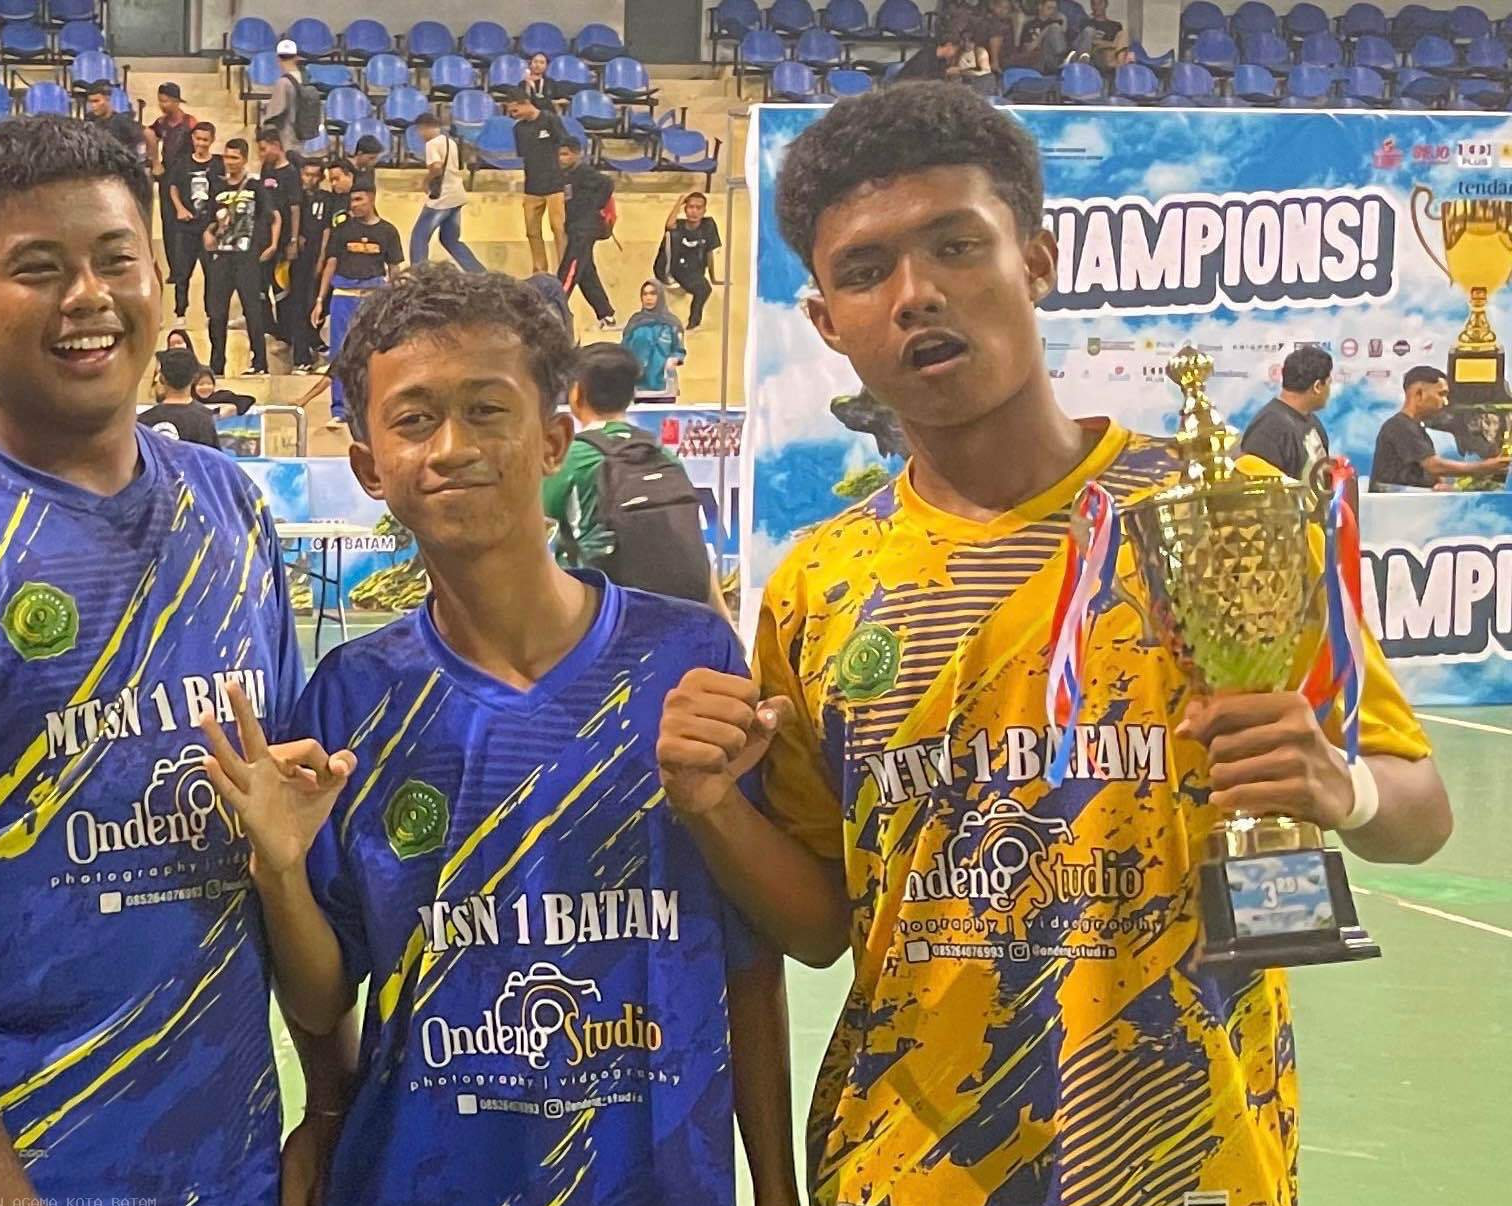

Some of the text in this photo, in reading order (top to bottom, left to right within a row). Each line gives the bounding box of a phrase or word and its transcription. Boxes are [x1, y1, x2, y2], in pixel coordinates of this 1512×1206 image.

[1043, 199, 1381, 294] HAMPIONS!
[344, 537, 394, 551] BATAM
[150, 682, 178, 732] 1
[967, 728, 993, 782] 1
[66, 802, 212, 866] Ondeng
[903, 847, 1143, 912] ndeng Studio
[511, 893, 531, 945] 1
[541, 888, 680, 945] BATAM
[421, 1003, 663, 1070] Ondeng Studio
